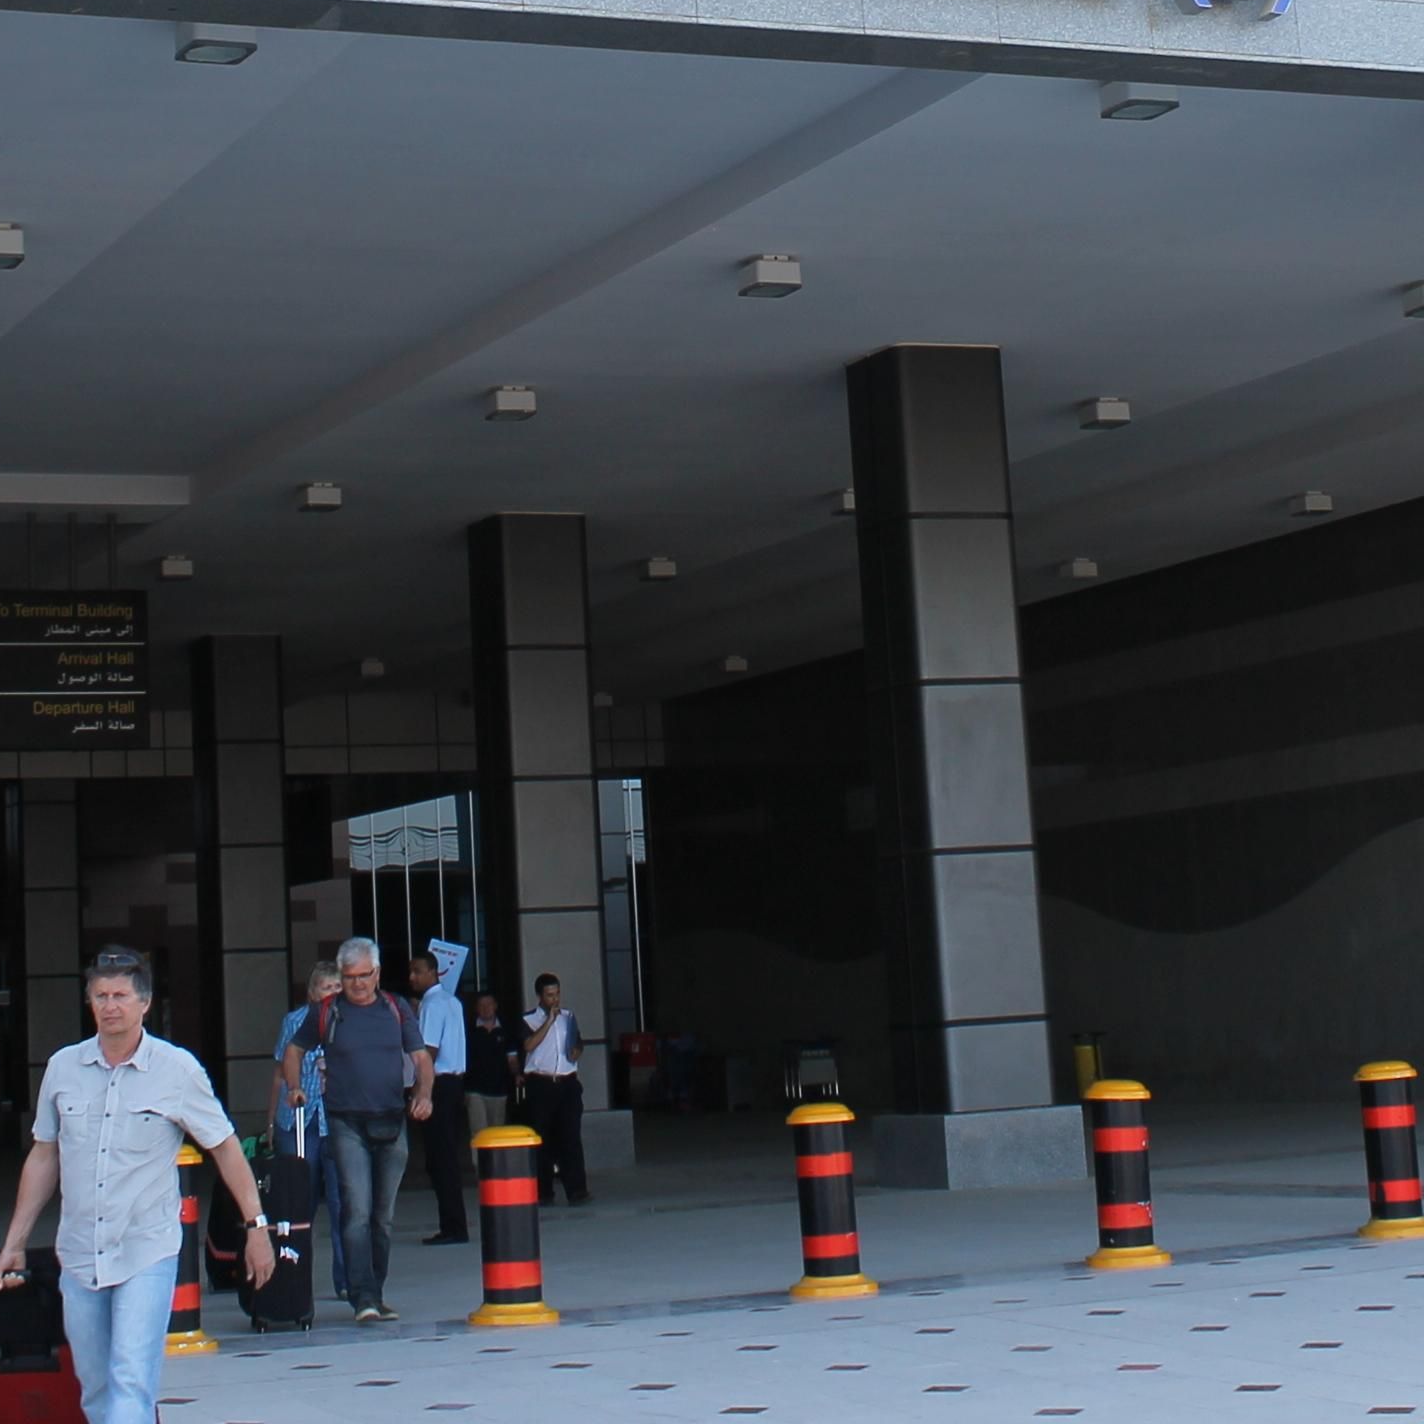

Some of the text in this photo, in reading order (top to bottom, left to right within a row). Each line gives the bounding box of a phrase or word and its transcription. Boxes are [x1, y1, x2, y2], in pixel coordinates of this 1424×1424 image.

[13, 603, 73, 617] Terminal
[77, 603, 133, 620] Building
[44, 624, 80, 637] المطار
[57, 651, 134, 665] Arrival Hall
[57, 671, 134, 685] صالة الوصول
[32, 700, 135, 717] Departure Hall
[72, 720, 135, 734] صالة السفر
